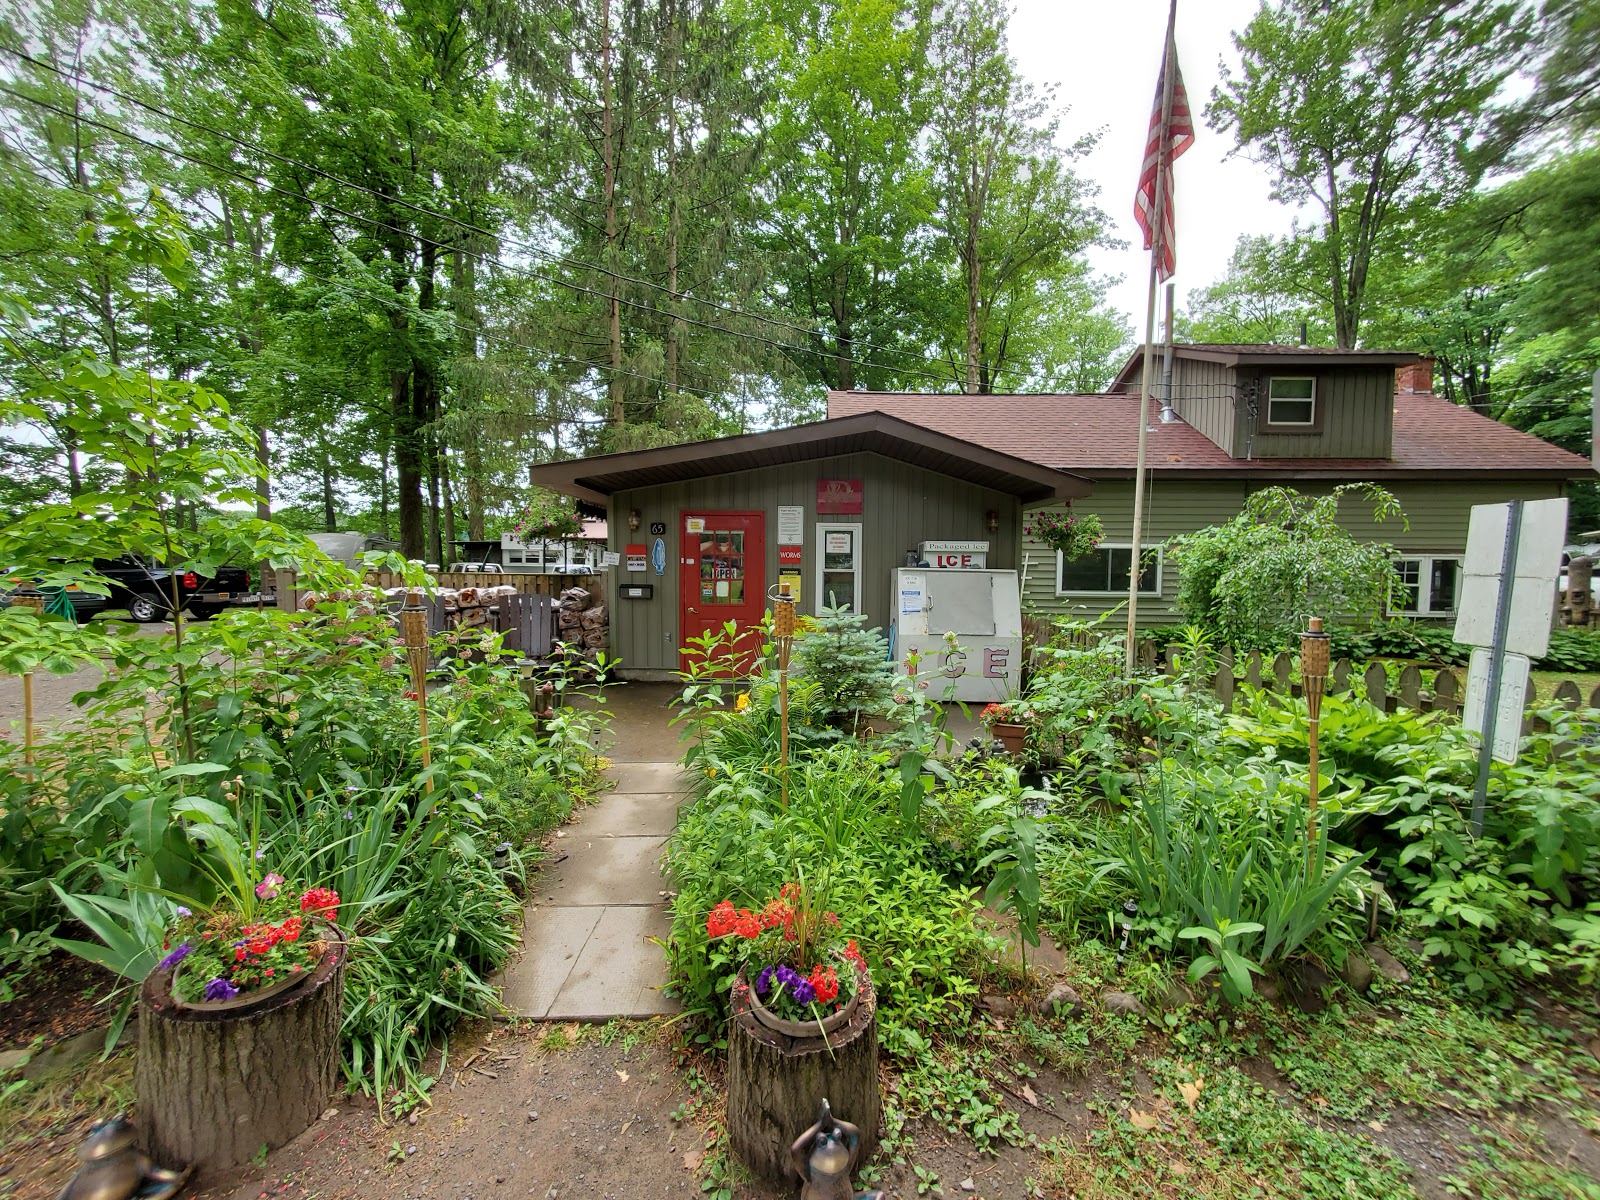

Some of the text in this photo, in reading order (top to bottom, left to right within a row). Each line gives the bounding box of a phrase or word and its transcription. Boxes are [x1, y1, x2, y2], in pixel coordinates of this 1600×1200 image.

[652, 524, 663, 534] 65
[780, 551, 801, 559] WORMS
[937, 554, 972, 567] ICE
[715, 568, 736, 579] OPEN
[908, 644, 1010, 679] ICE
